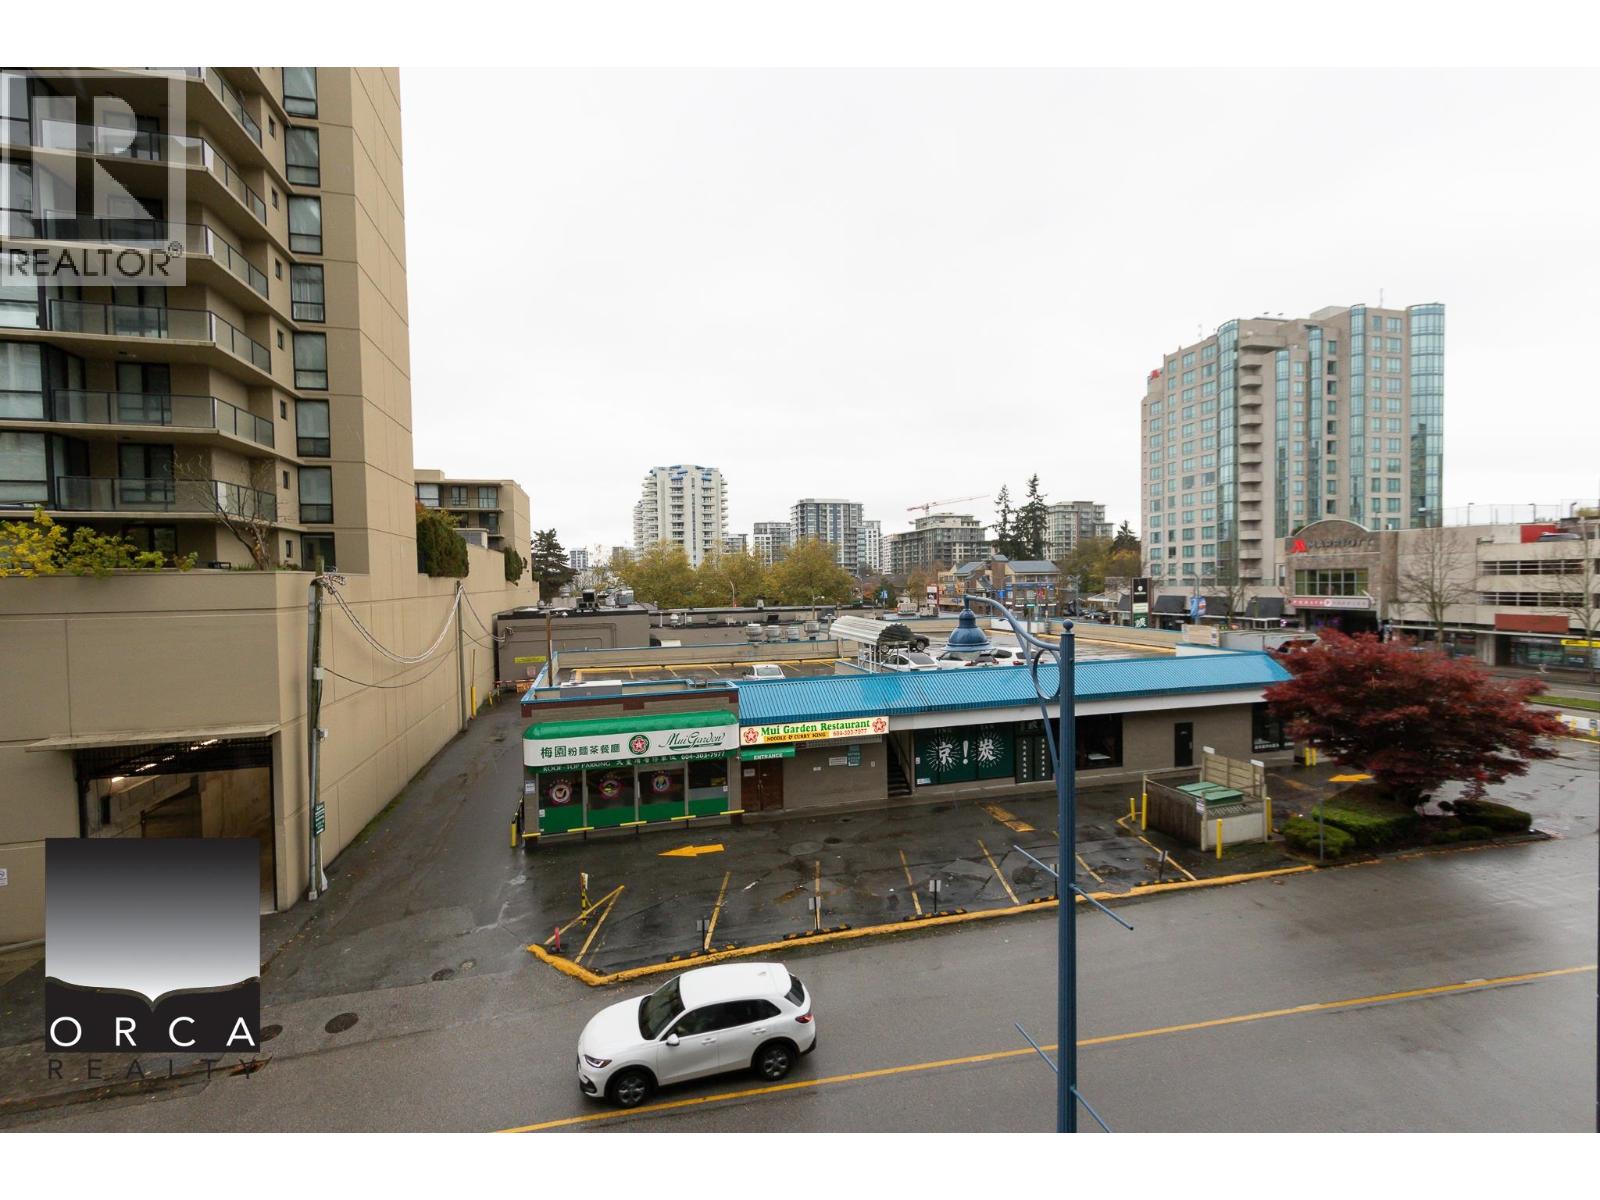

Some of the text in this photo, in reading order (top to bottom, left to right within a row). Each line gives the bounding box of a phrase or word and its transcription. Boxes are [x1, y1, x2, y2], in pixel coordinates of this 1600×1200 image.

[761, 719, 870, 736] Mui Garden Restaurant
[658, 731, 726, 749] Mui Garden
